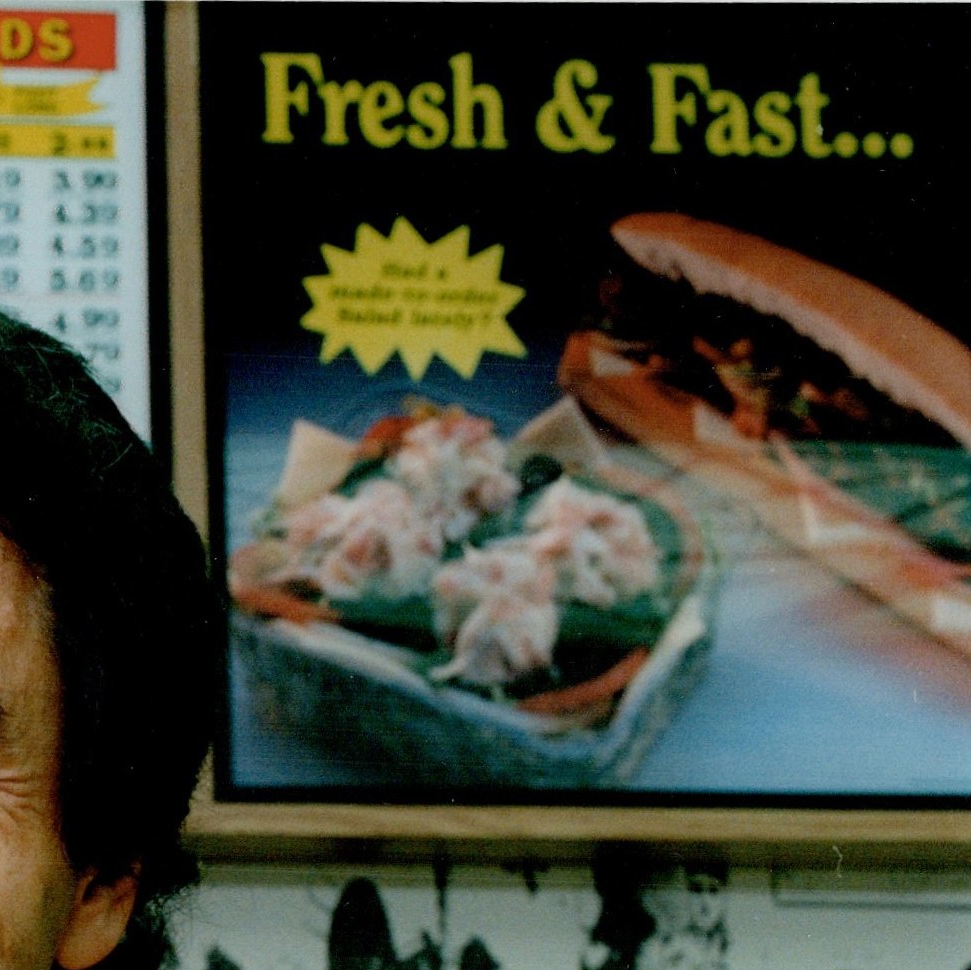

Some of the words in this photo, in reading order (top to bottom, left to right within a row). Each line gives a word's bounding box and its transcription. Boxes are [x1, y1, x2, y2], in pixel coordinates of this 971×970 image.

[260, 52, 509, 150] Fresh
[535, 58, 617, 154] &
[647, 63, 914, 159] Fast...
